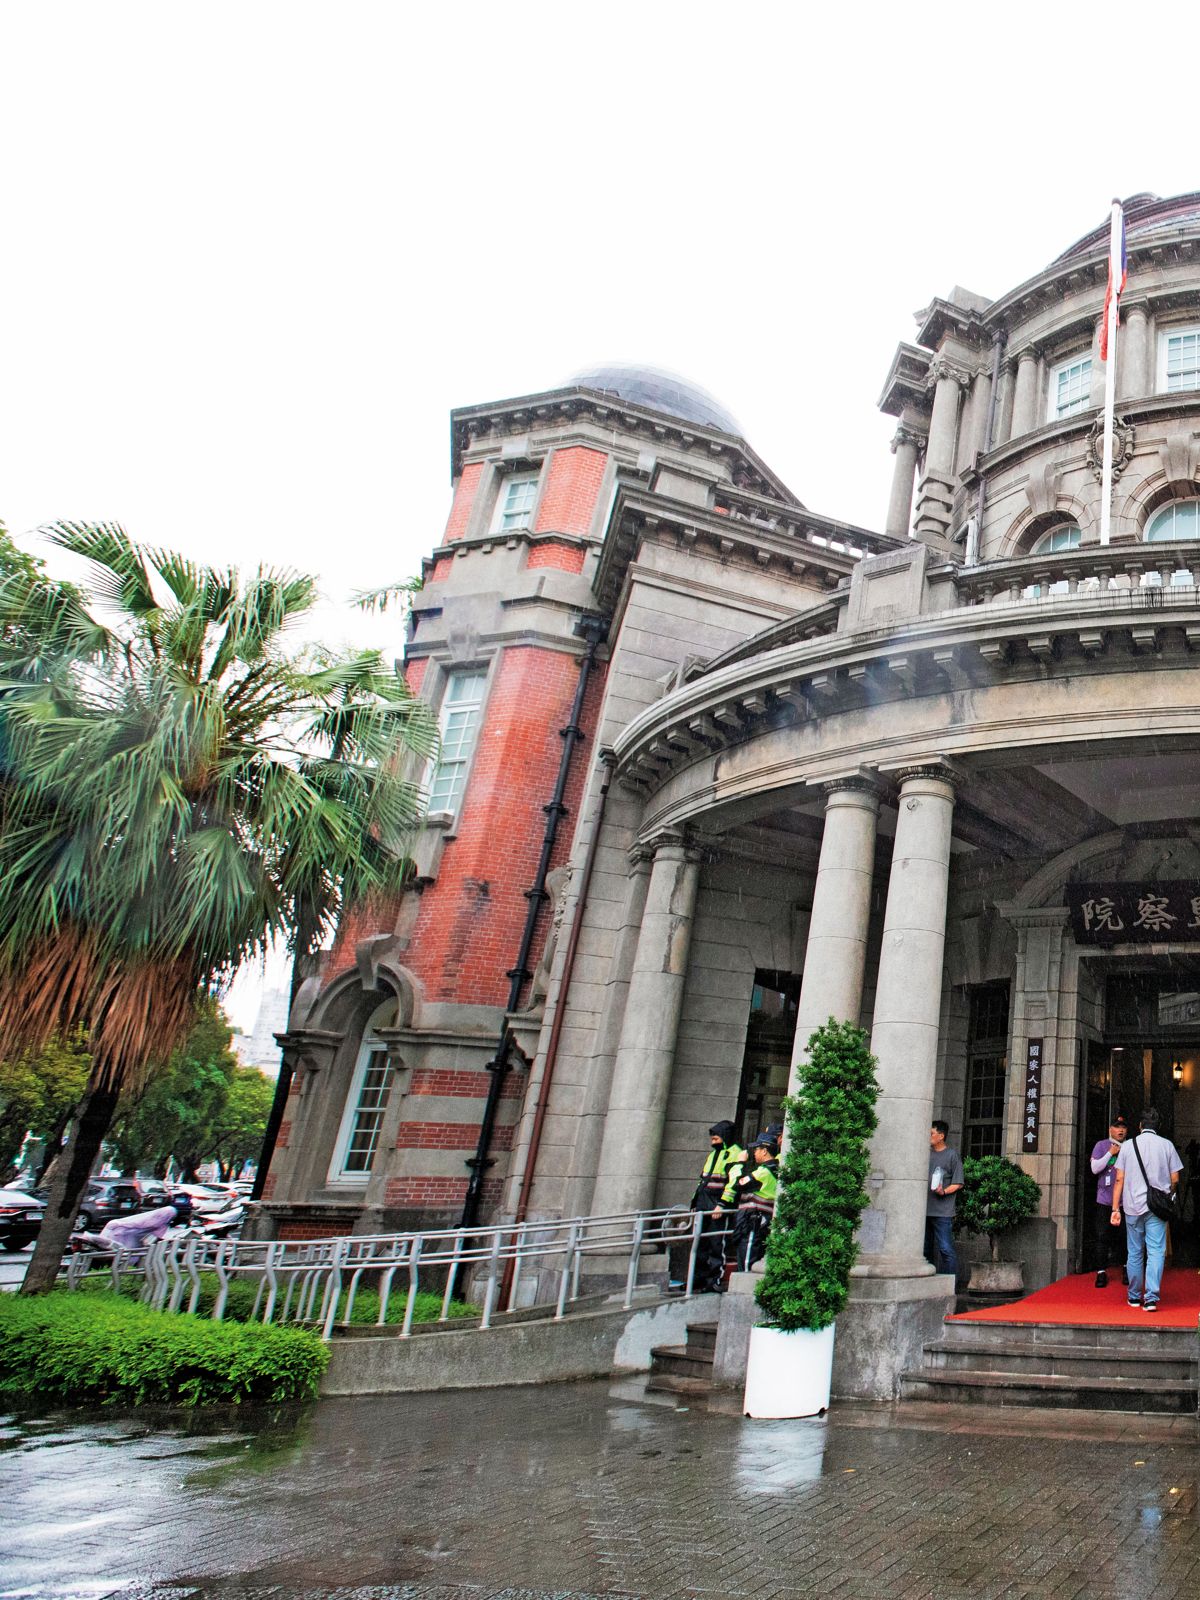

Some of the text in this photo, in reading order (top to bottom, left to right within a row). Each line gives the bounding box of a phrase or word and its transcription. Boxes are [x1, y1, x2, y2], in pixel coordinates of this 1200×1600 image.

[1024, 1045, 1040, 1143] 國家人權委員會
